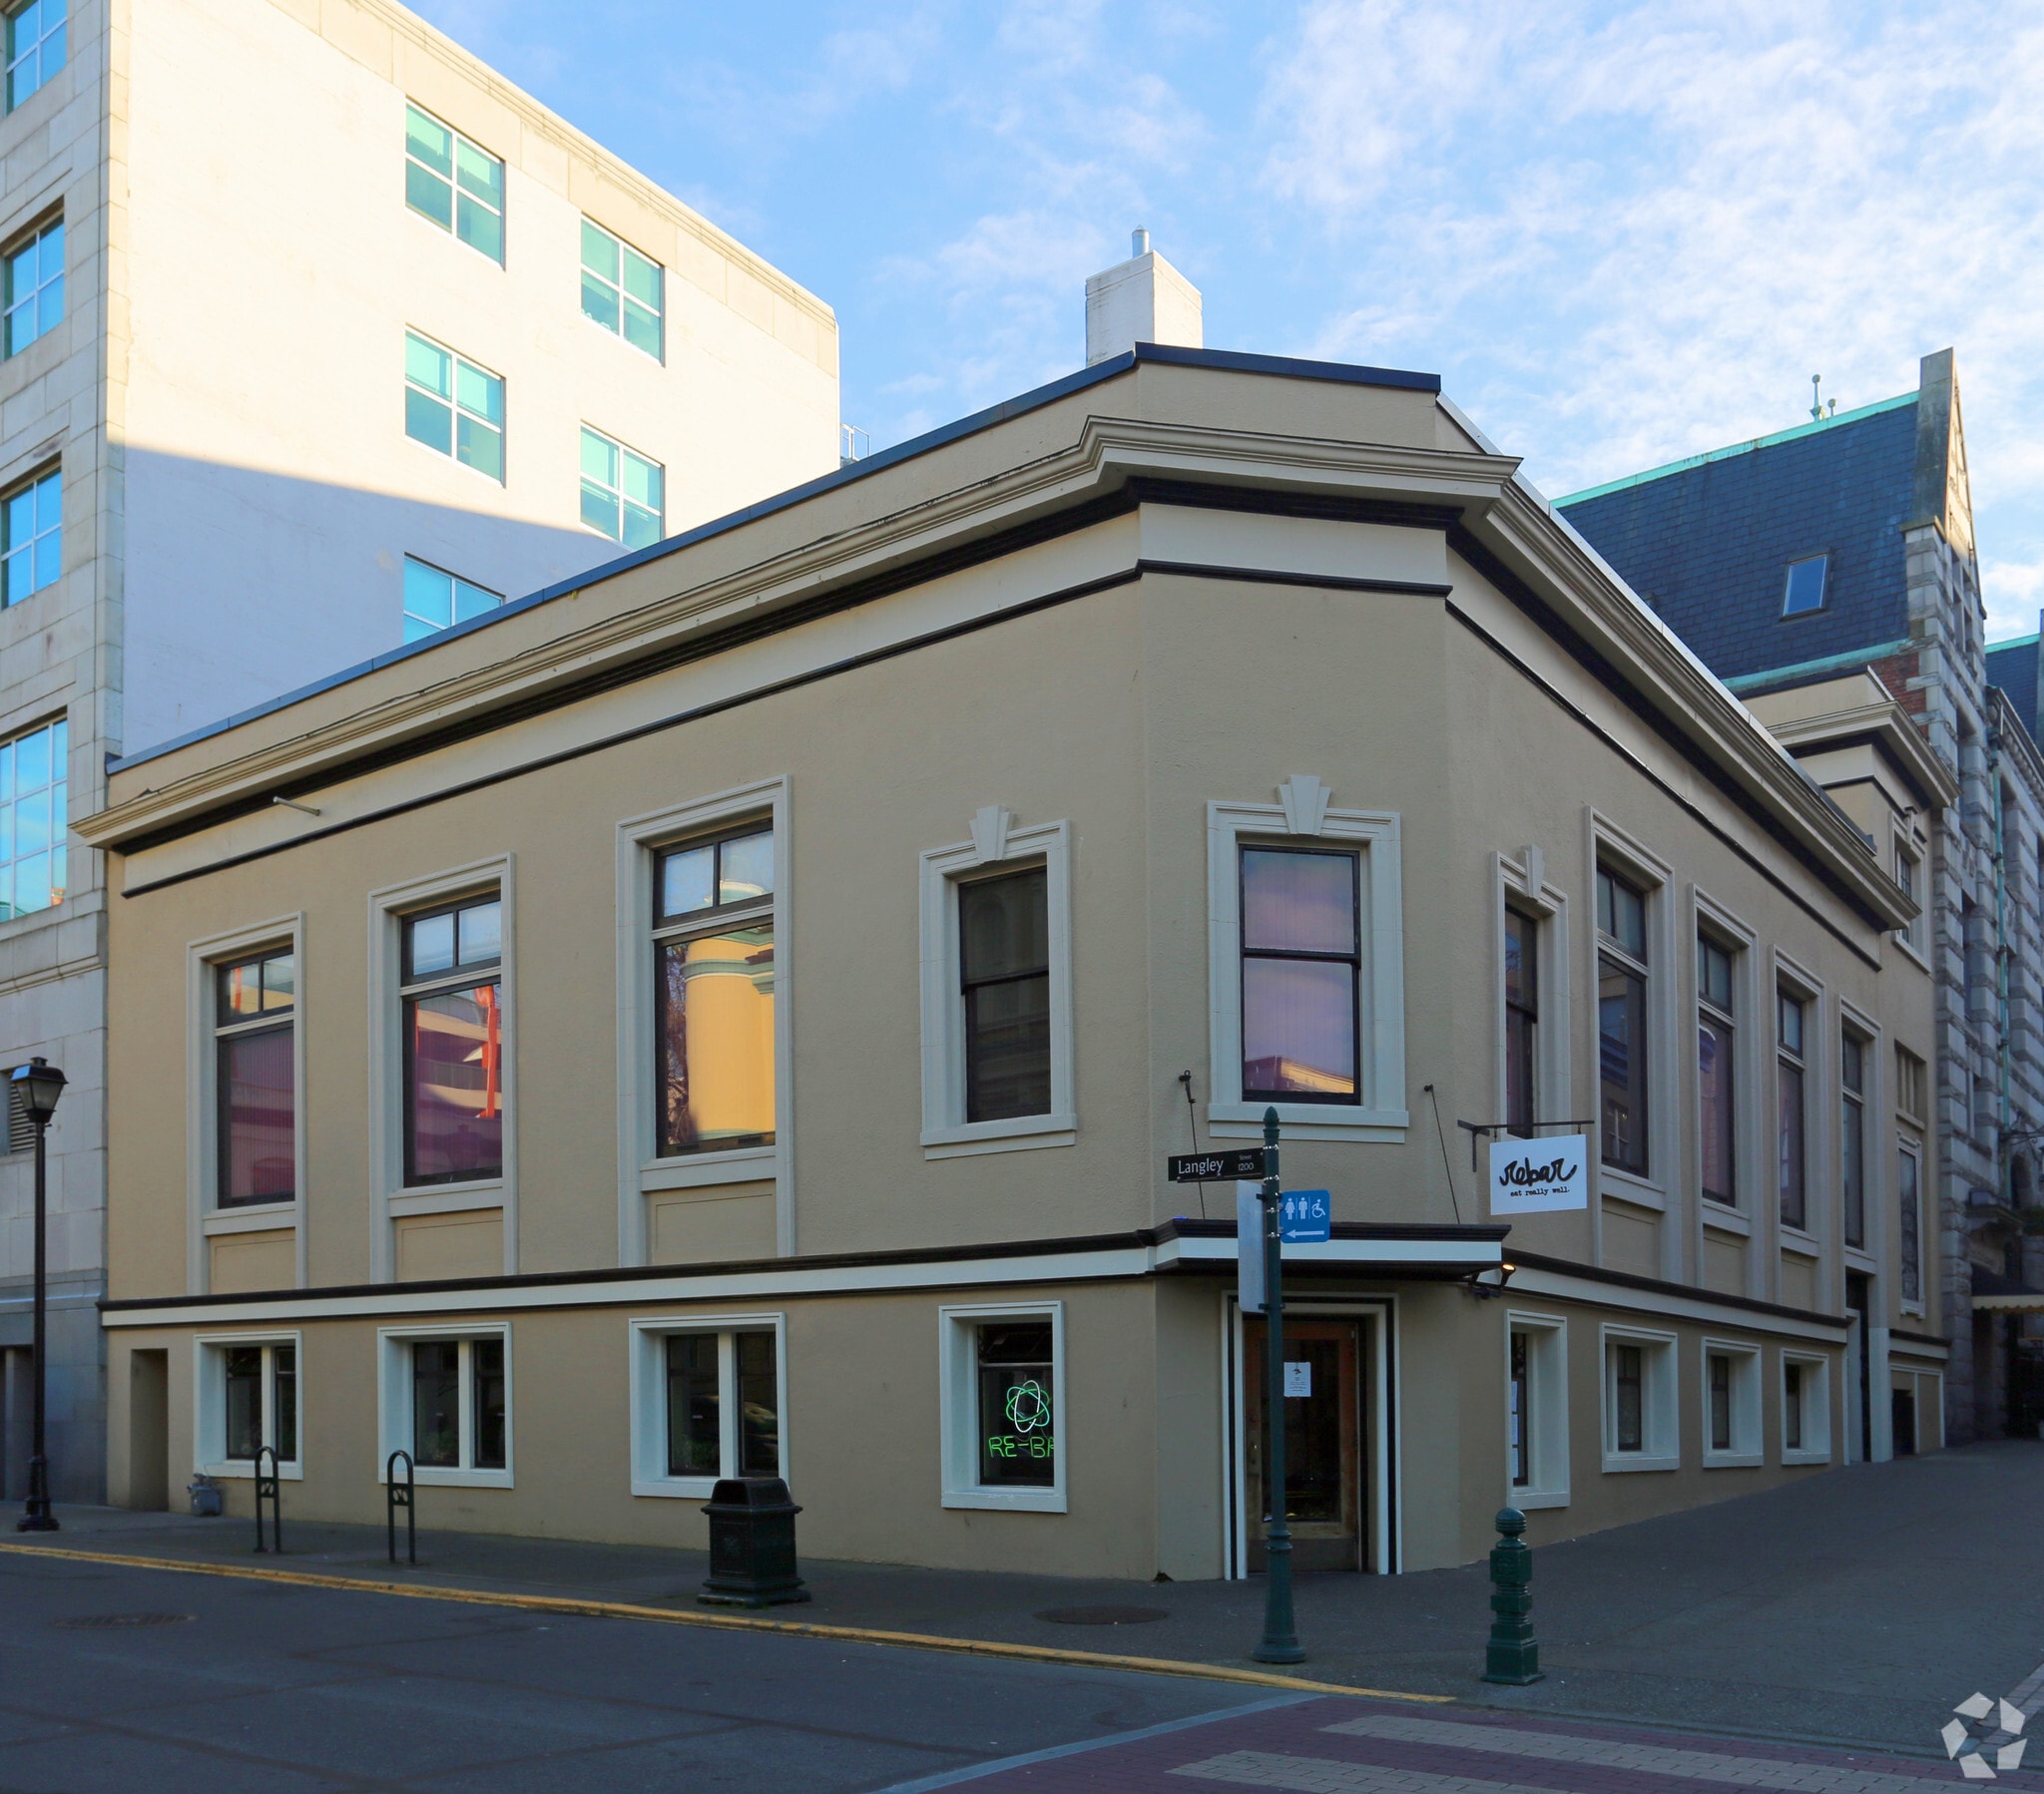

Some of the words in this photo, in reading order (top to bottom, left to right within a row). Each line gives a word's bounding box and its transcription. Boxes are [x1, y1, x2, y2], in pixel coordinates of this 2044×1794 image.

[1178, 1157, 1224, 1175] Langley
[1238, 1162, 1255, 1171] 1200
[1499, 1157, 1578, 1186] rebar
